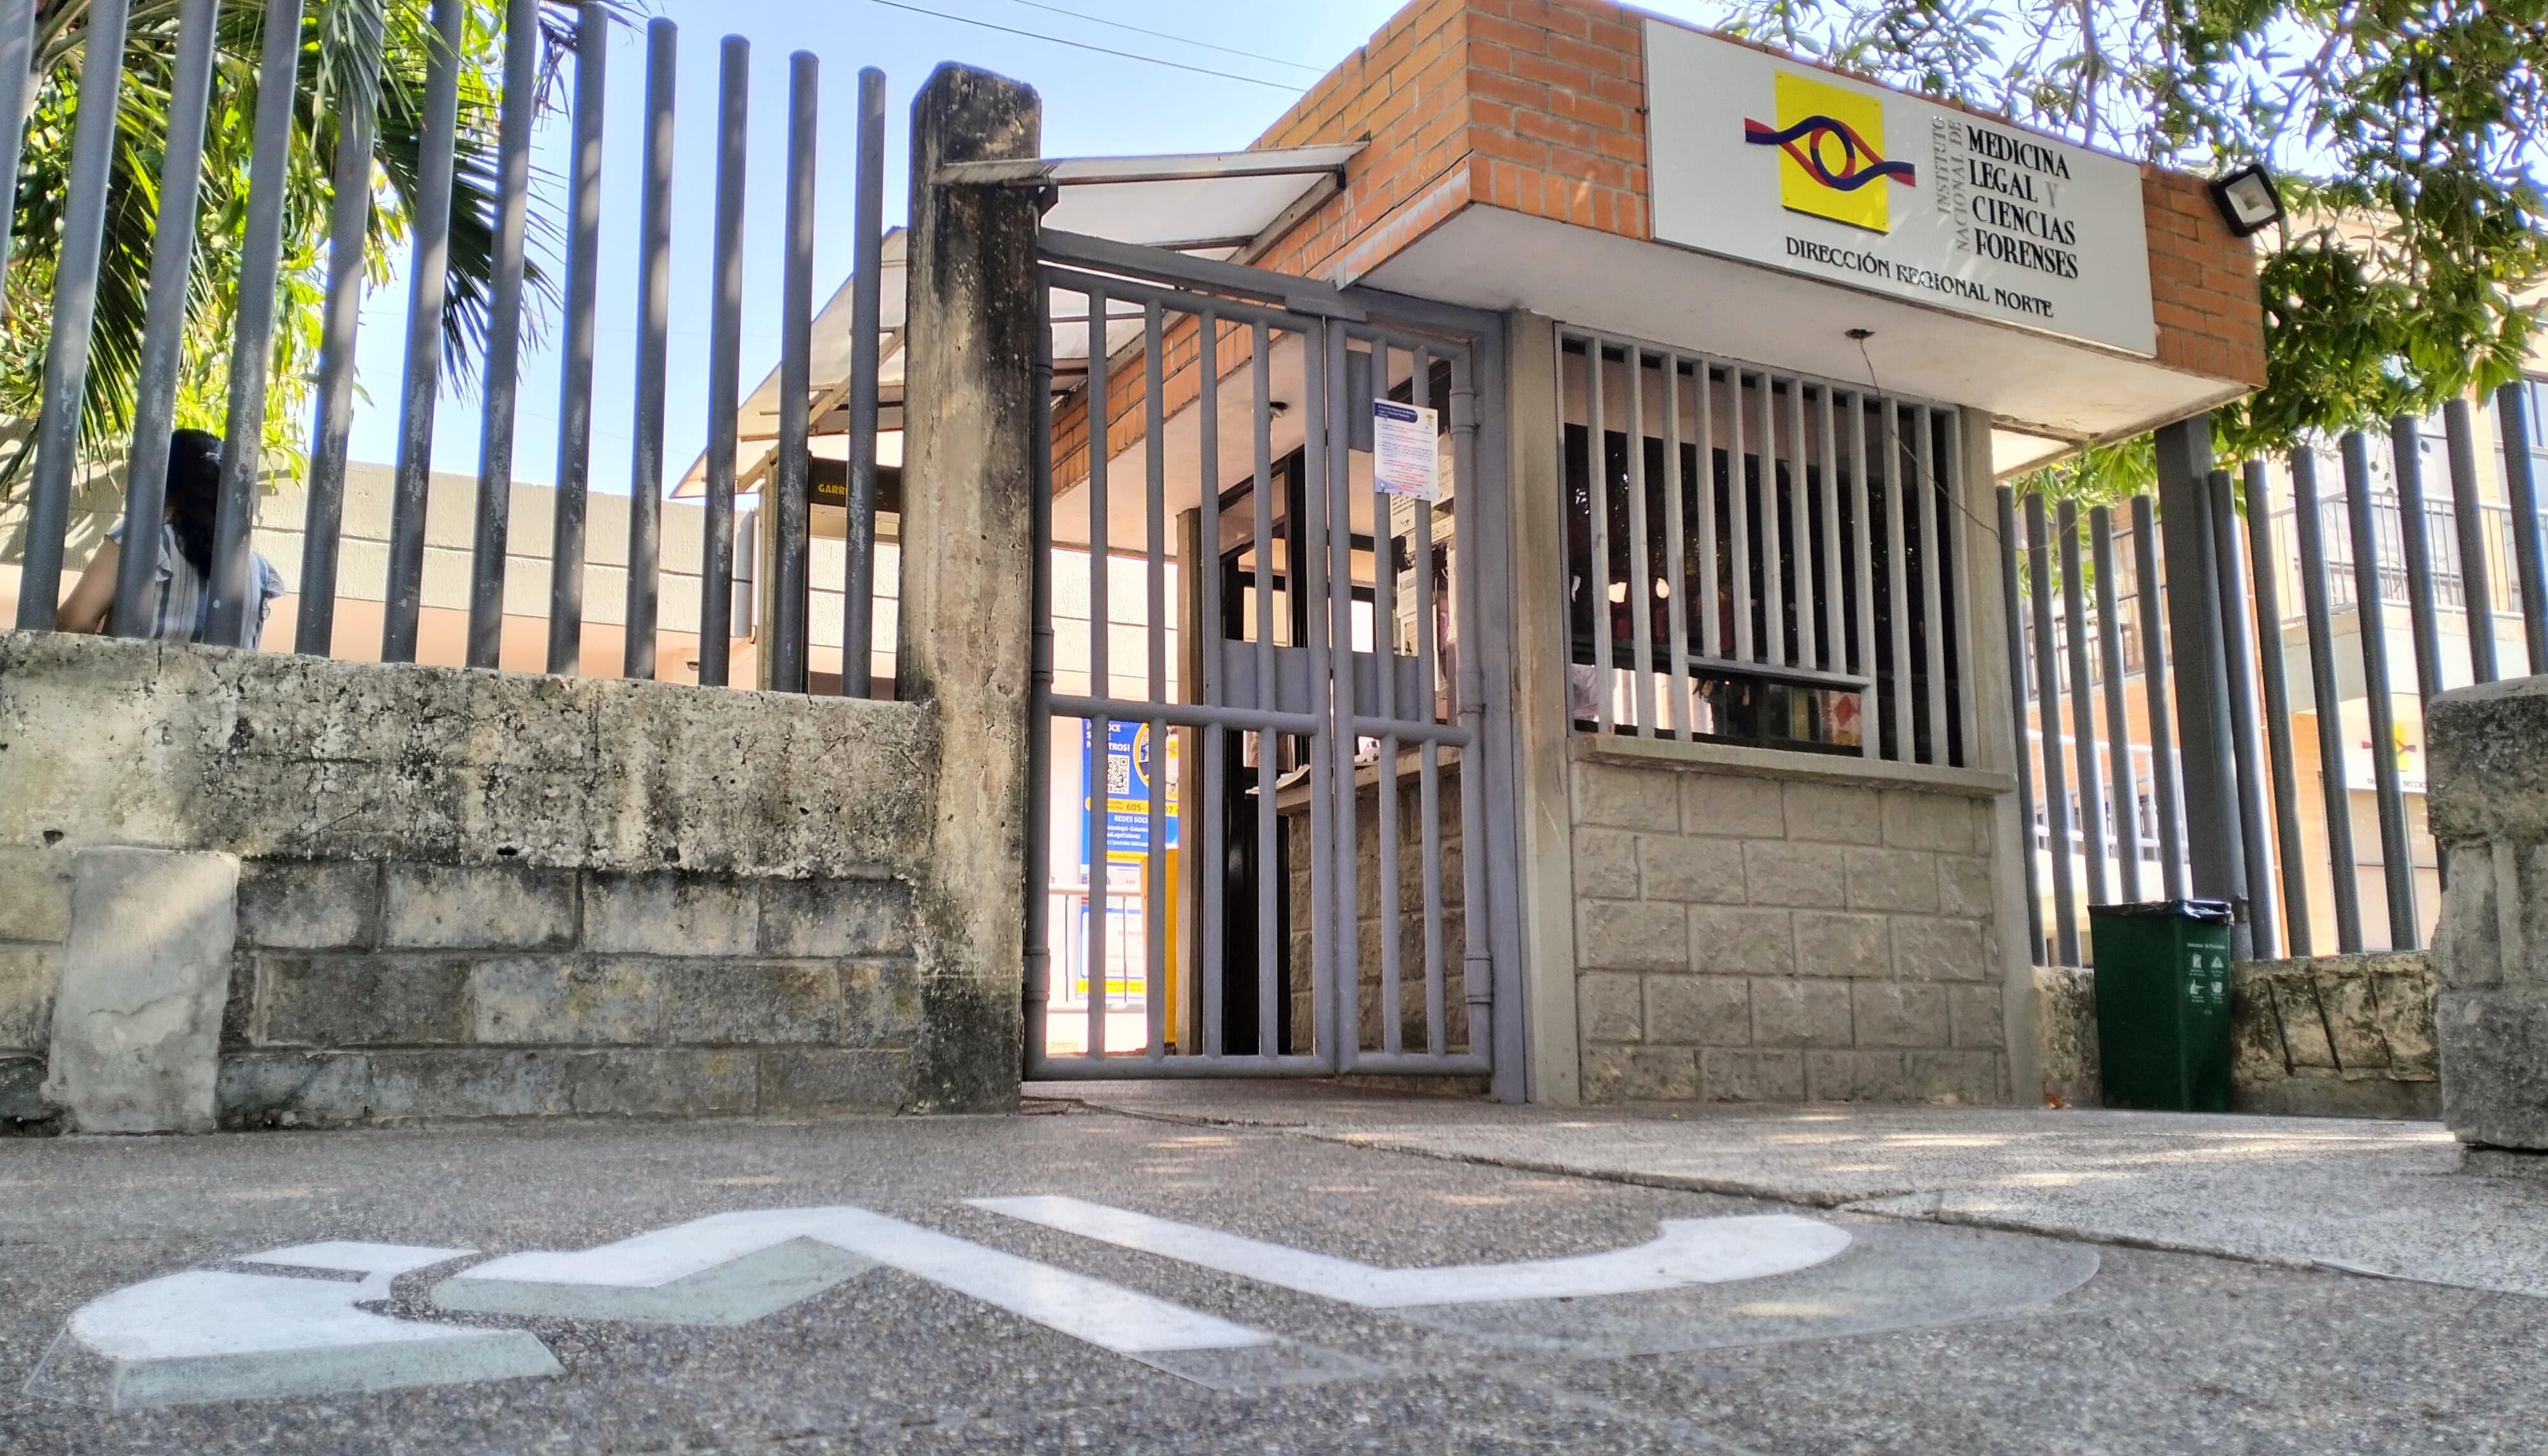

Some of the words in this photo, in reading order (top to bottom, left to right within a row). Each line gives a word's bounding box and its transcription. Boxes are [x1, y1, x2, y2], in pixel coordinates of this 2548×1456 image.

[1949, 120, 1963, 146] DE
[1966, 124, 2072, 181] MEDICINA
[1932, 116, 1951, 215] INSTITUTO
[1968, 158, 2038, 204] LEGAL
[2045, 181, 2060, 209] Y
[1951, 153, 1970, 254] NACIONAL
[1972, 195, 2077, 246] CIENCIAS
[1786, 237, 1891, 278] DIRECCIÓN
[1896, 263, 1990, 302] REGIONAL
[1995, 287, 2055, 318] NORTE
[1974, 227, 2079, 280] FORENSES
[817, 483, 847, 496] GARR
